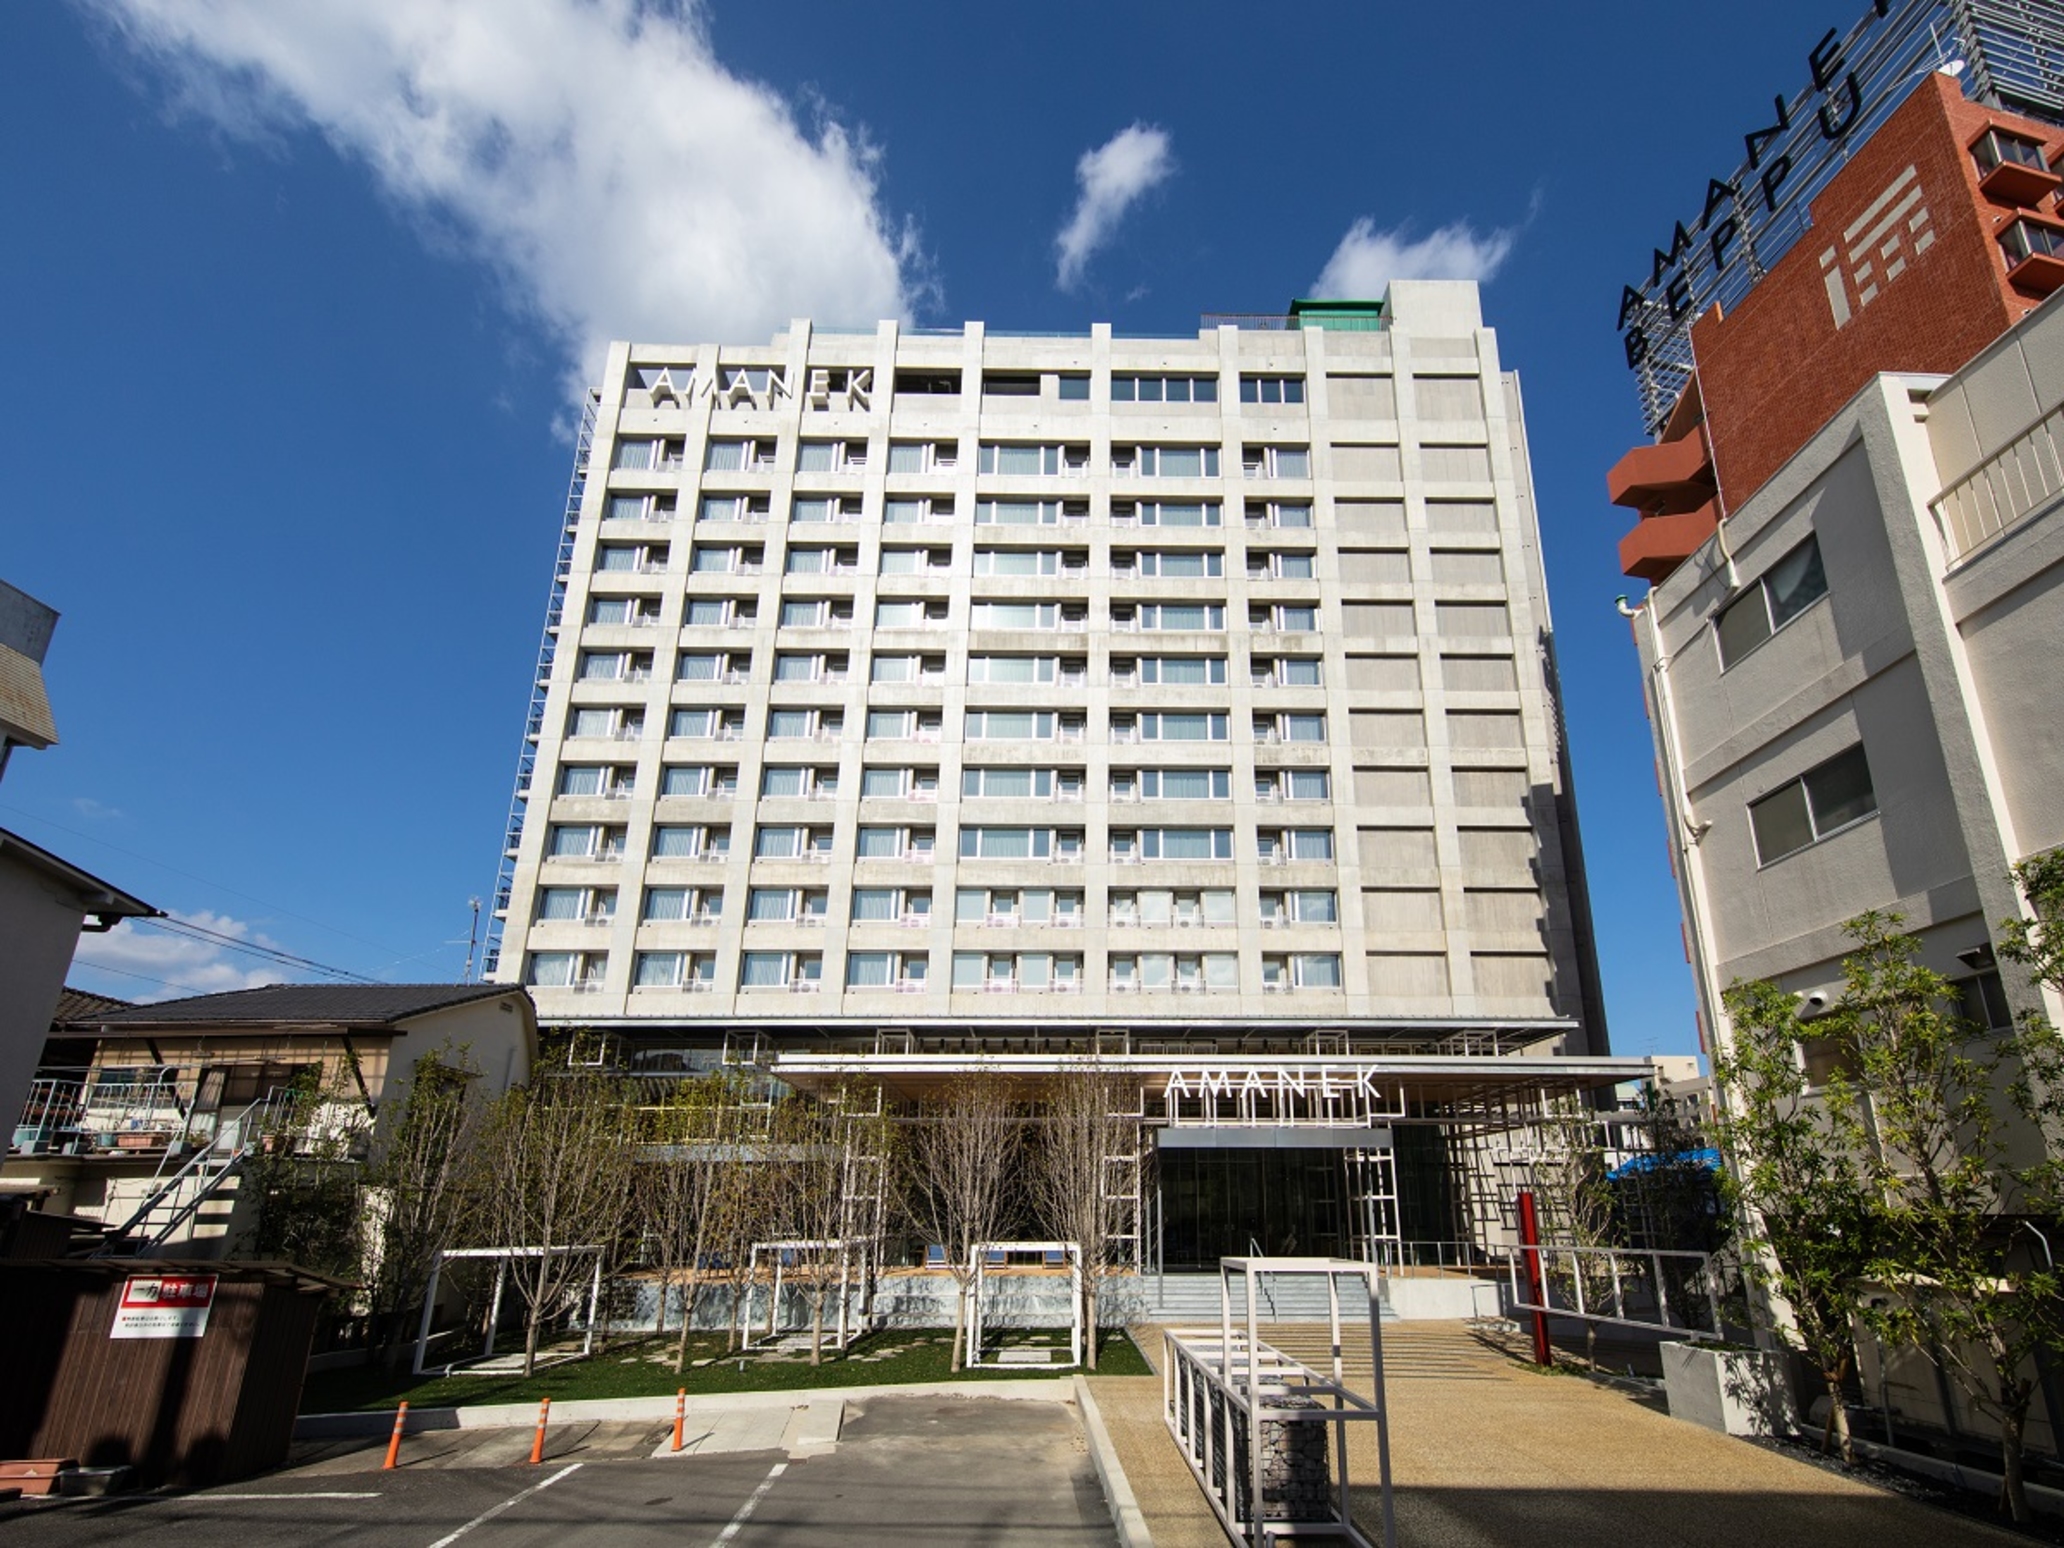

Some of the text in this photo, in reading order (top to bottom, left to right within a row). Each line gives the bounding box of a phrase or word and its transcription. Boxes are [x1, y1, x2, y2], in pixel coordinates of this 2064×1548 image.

[1617, 0, 1889, 332] AMANE
[1623, 71, 1863, 370] BEPPU
[649, 366, 871, 409] AMANEK
[1163, 1064, 1382, 1099] AMANEK
